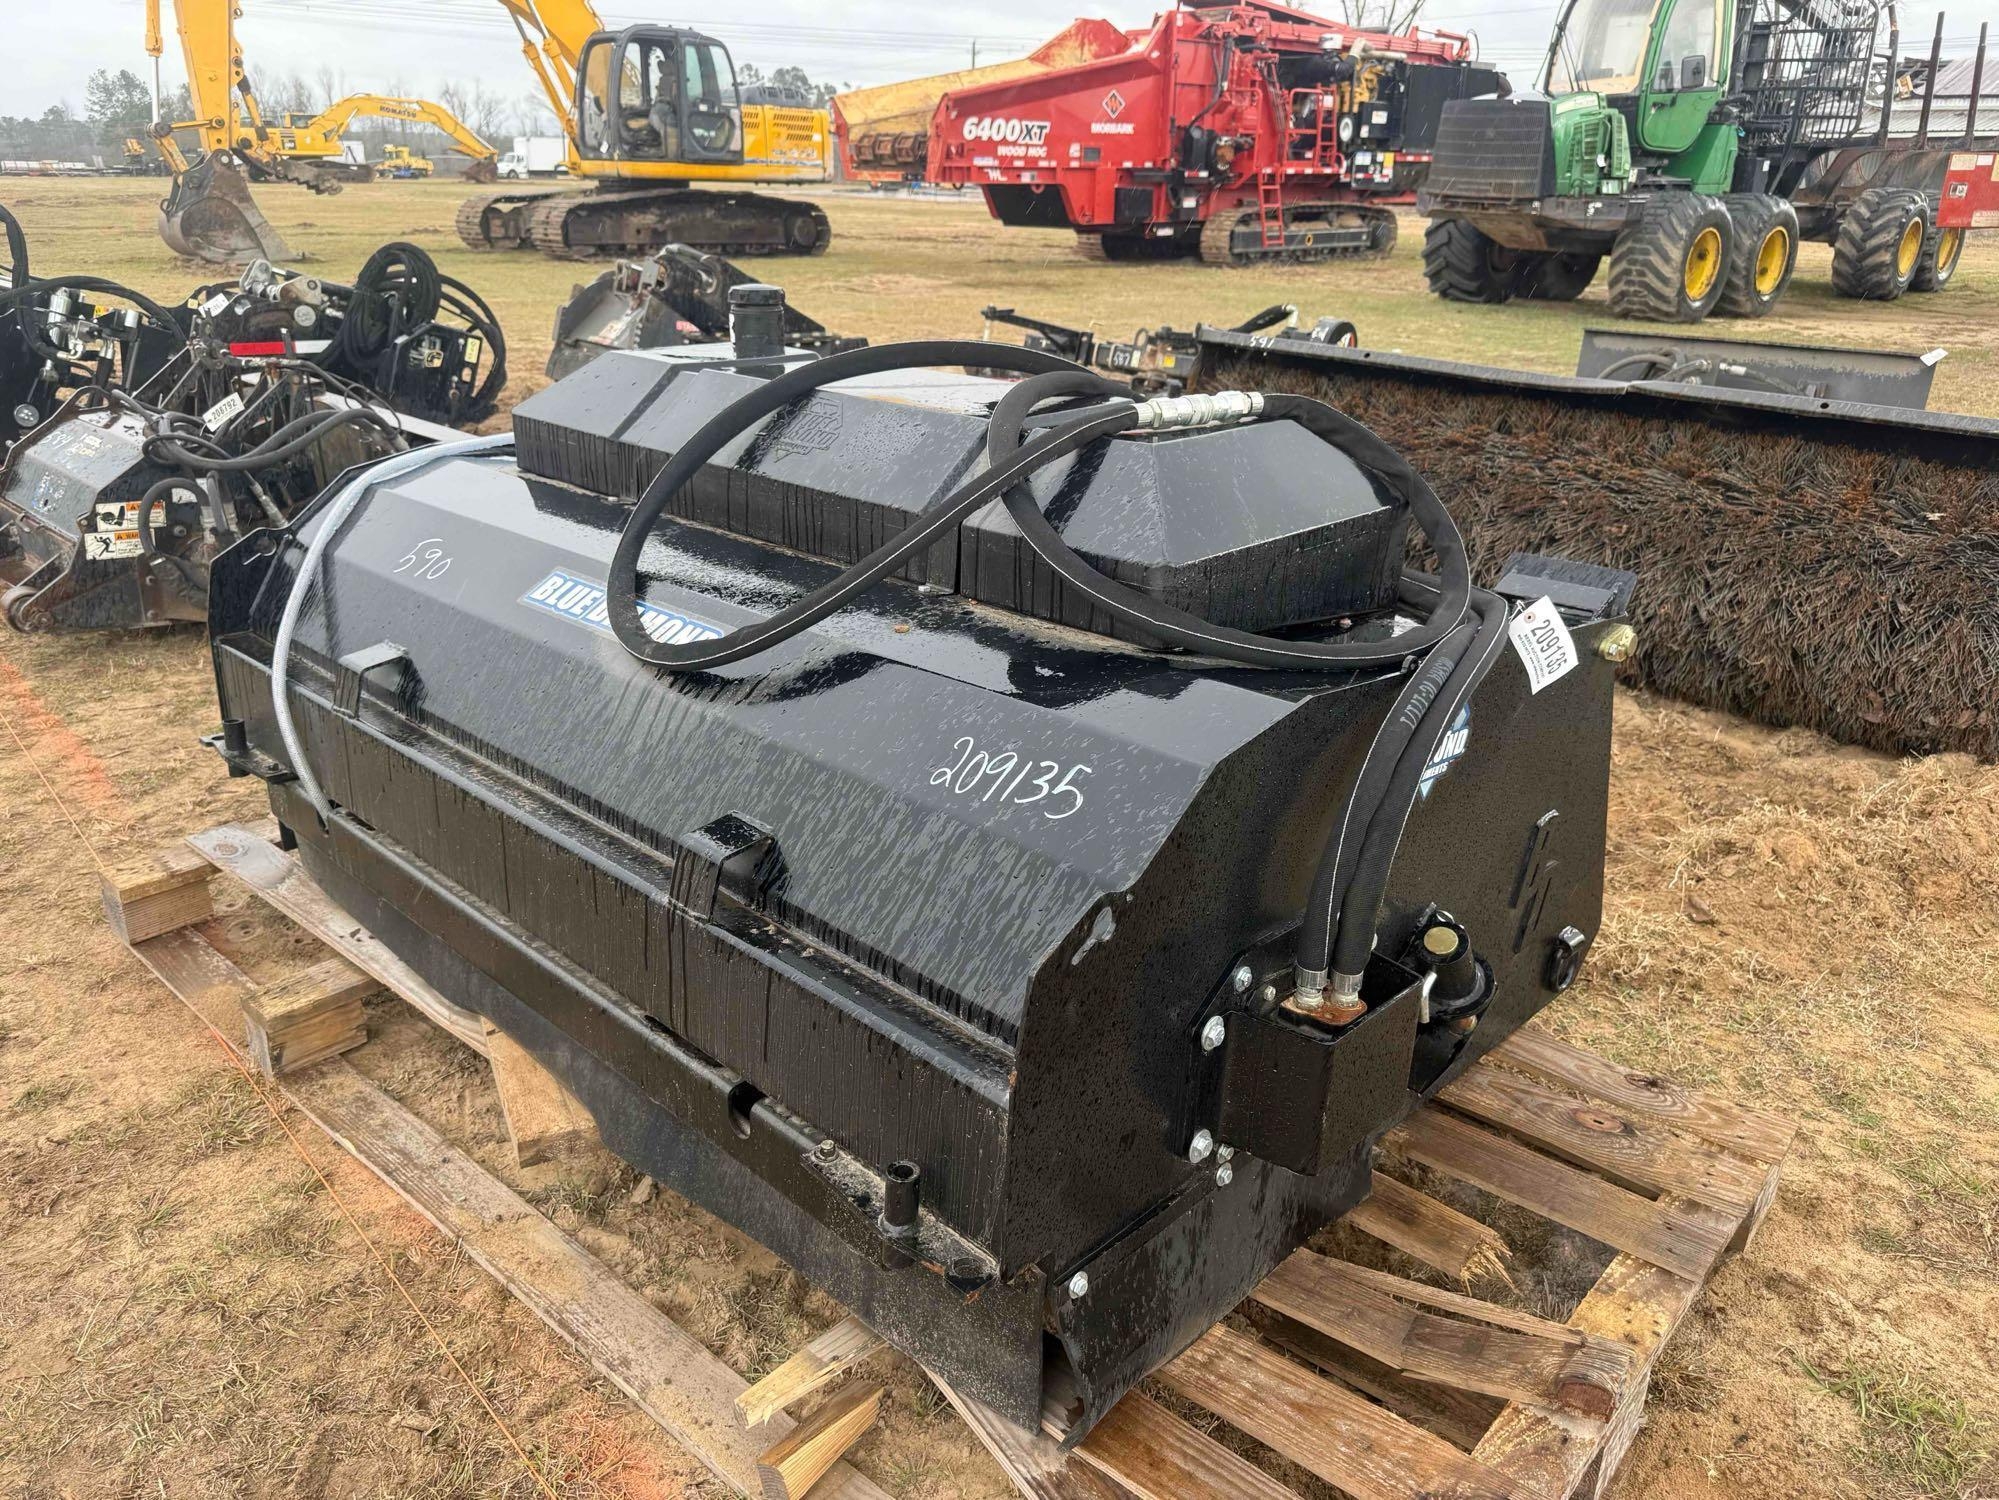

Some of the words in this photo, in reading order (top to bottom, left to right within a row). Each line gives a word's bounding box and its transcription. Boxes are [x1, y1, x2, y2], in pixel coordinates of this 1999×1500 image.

[379, 105, 417, 119] KOMATSU
[963, 117, 1050, 145] 6400XT
[997, 145, 1027, 157] WOOD
[1027, 146, 1048, 158] HOG
[392, 538, 454, 579] 590
[528, 575, 605, 615] BLUE
[1530, 618, 1568, 675] 209135
[929, 736, 1093, 819] 209135
